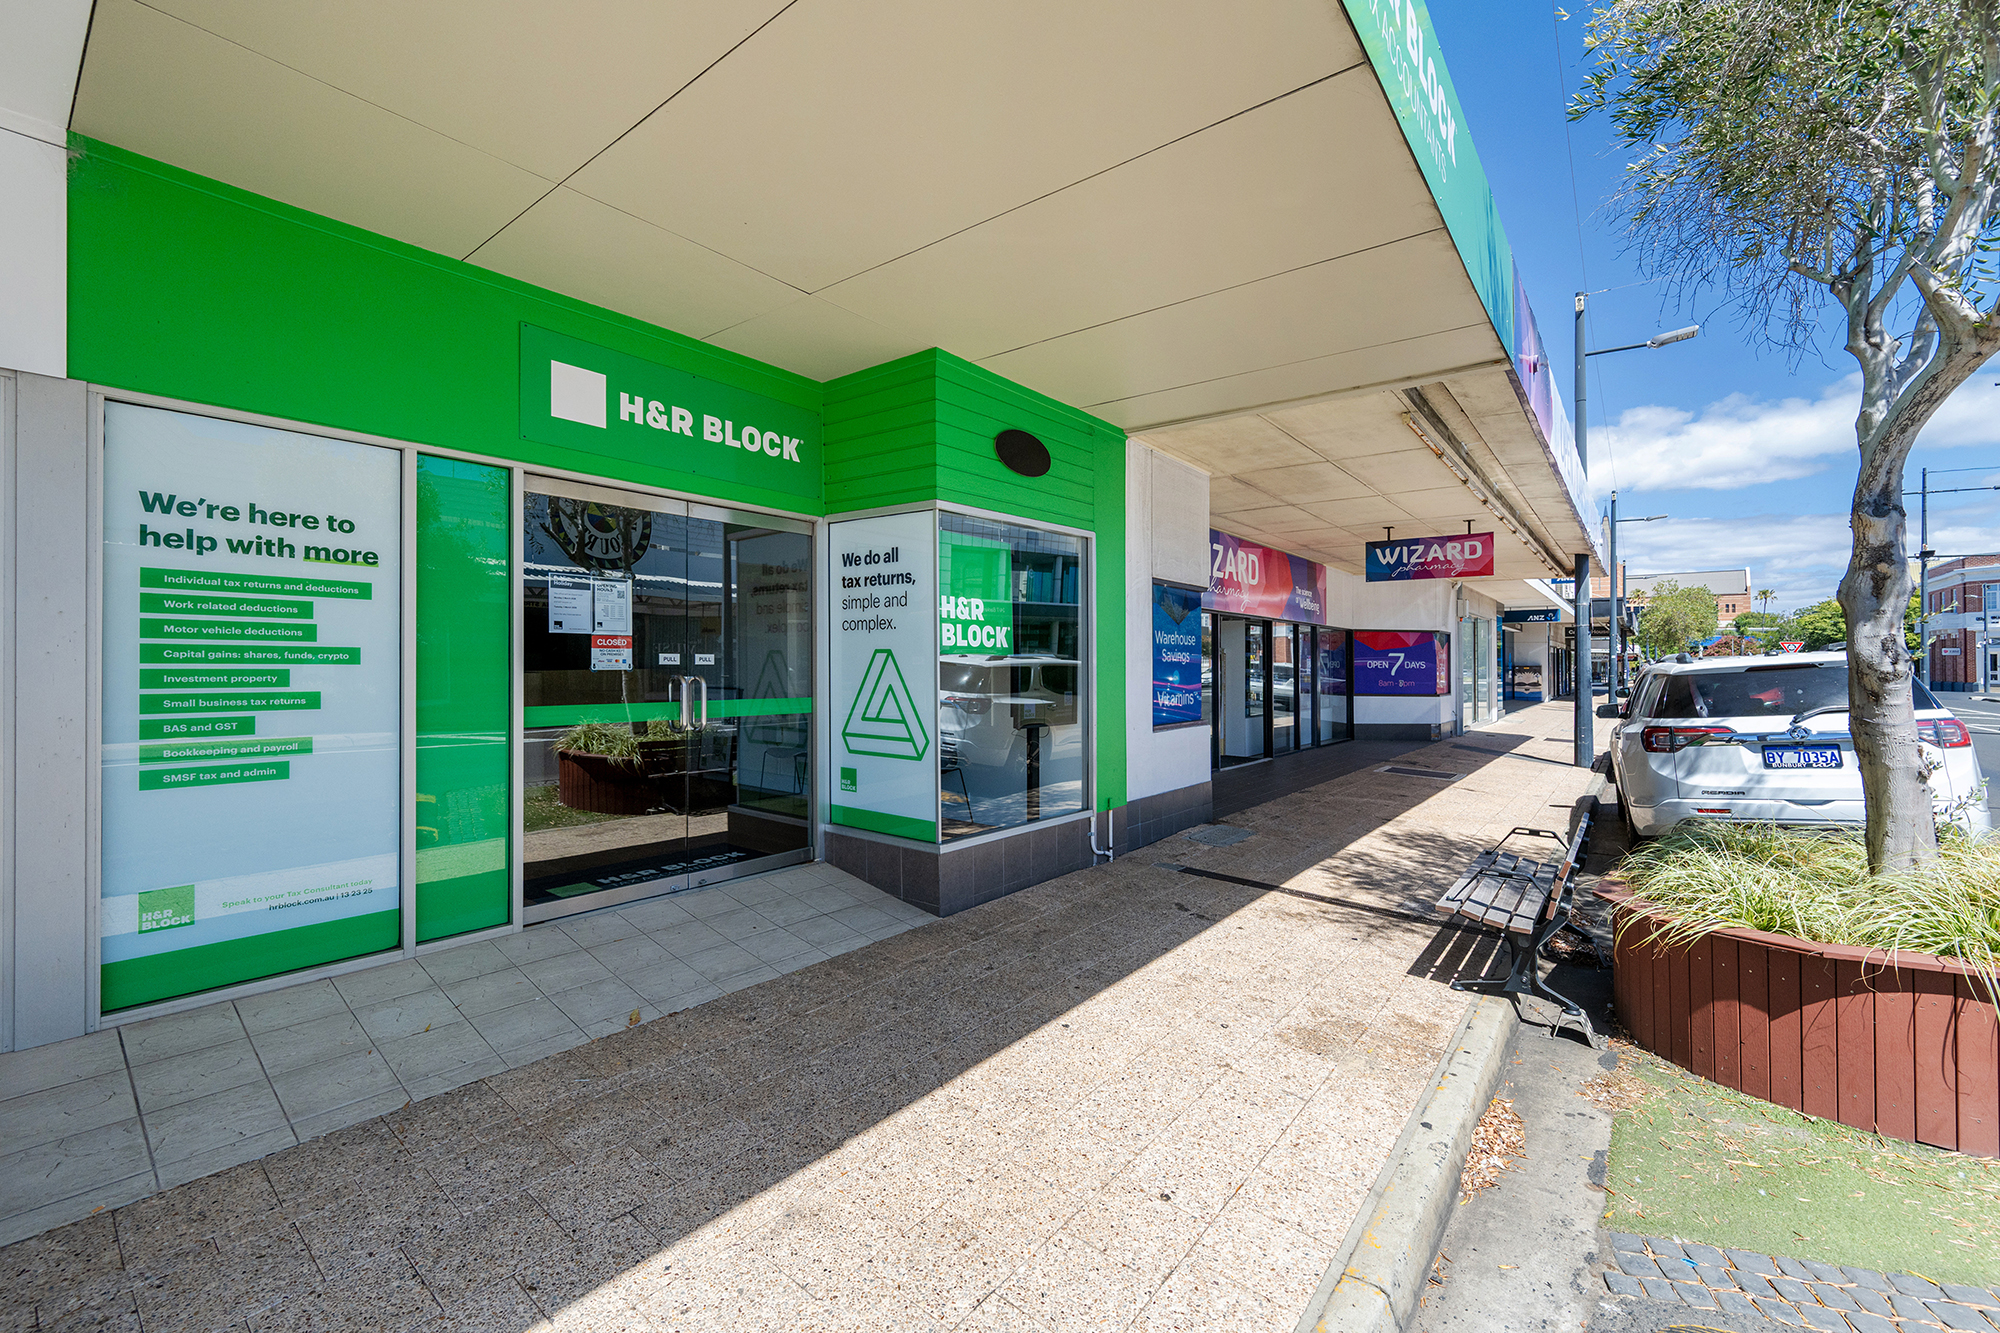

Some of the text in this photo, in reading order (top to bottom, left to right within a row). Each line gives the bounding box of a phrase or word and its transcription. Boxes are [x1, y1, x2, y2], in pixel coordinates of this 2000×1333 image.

[1406, 0, 1457, 168] BLOCK
[1382, 11, 1447, 183] ACCOUNTANTS
[620, 391, 801, 463] H&R BLOCK
[138, 490, 356, 534] We're here to
[139, 523, 379, 566] help with more
[1375, 541, 1483, 565] WIZARD
[842, 547, 899, 567] We do all
[1209, 543, 1259, 586] ZARD
[1391, 561, 1469, 578] pharmacy
[163, 574, 359, 595] Individual tax returns and deductions
[842, 571, 916, 588] tax returns,
[842, 591, 908, 612] simple and
[1207, 577, 1251, 612] harmacy
[163, 599, 298, 614] Work related deductions
[941, 595, 985, 621] H&R
[842, 616, 897, 633] complex.
[1527, 614, 1545, 622] ANZ
[163, 624, 303, 637] Motor vehicle deductions
[941, 622, 1009, 648] BLOCK
[1155, 630, 1196, 646] Warehouse
[596, 638, 628, 646] CLOSED
[163, 649, 349, 662] Capital gains: shares, funds, crypto
[1161, 648, 1191, 665] Savings
[1366, 653, 1426, 676] OPEN 7 DAYS
[163, 674, 278, 684] Investment property
[163, 696, 306, 709] Small business tax returns
[1157, 690, 1195, 707] Vitamins
[163, 722, 238, 733] BAS and GST
[163, 742, 299, 759] Bookkeeping and payroll
[1767, 751, 1840, 763] BY 7035A
[162, 767, 277, 783] SMSF tax and admin
[222, 879, 373, 909] Speak to your Tax Consultant today
[269, 894, 335, 911] hrblock.com.au
[340, 890, 349, 899] 13
[350, 888, 360, 897] 23
[362, 887, 373, 897] 25
[141, 908, 174, 922] H&R
[141, 914, 191, 931] BLOCK
